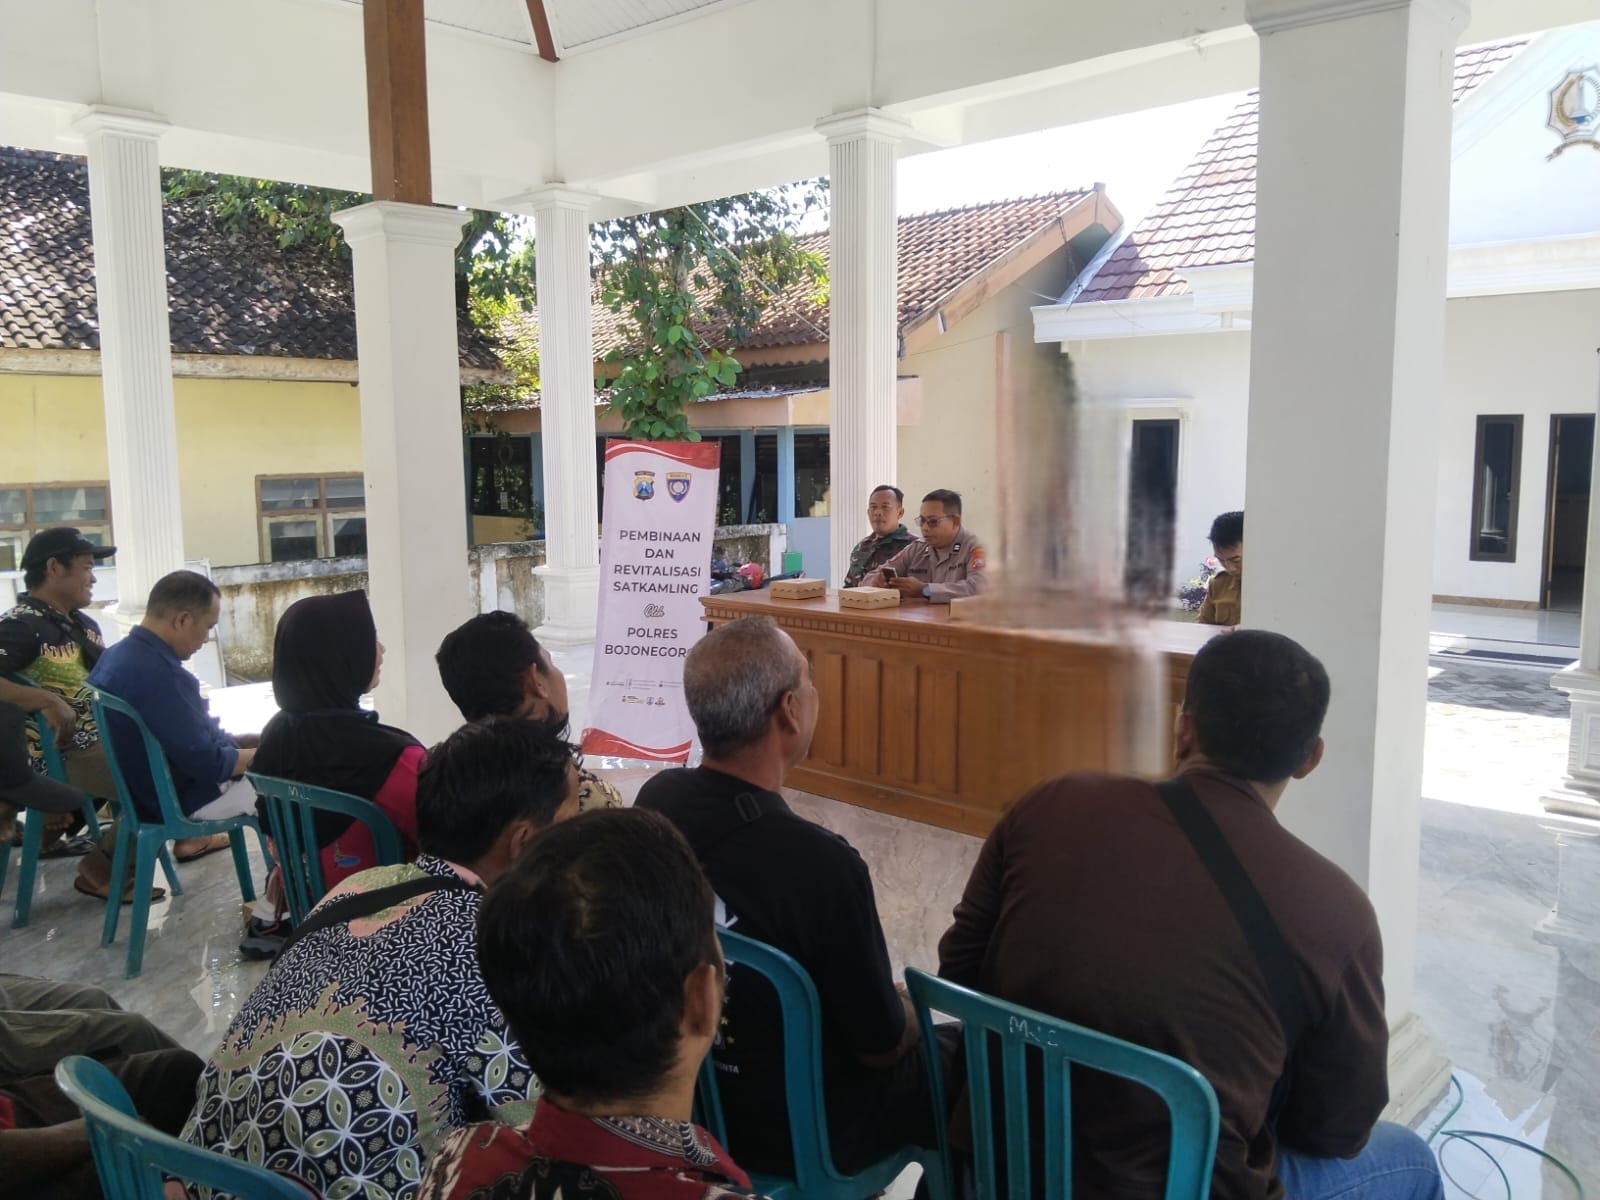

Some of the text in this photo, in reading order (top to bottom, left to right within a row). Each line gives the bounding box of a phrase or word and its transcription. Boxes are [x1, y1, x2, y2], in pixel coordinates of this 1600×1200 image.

[619, 530, 701, 542] PEMBINAAN
[645, 549, 674, 559] DAN
[613, 564, 702, 577] REVITALISASI
[613, 581, 699, 594] SATKAMLING
[627, 627, 678, 639] POLRES
[604, 644, 687, 657] BOJONEGOR
